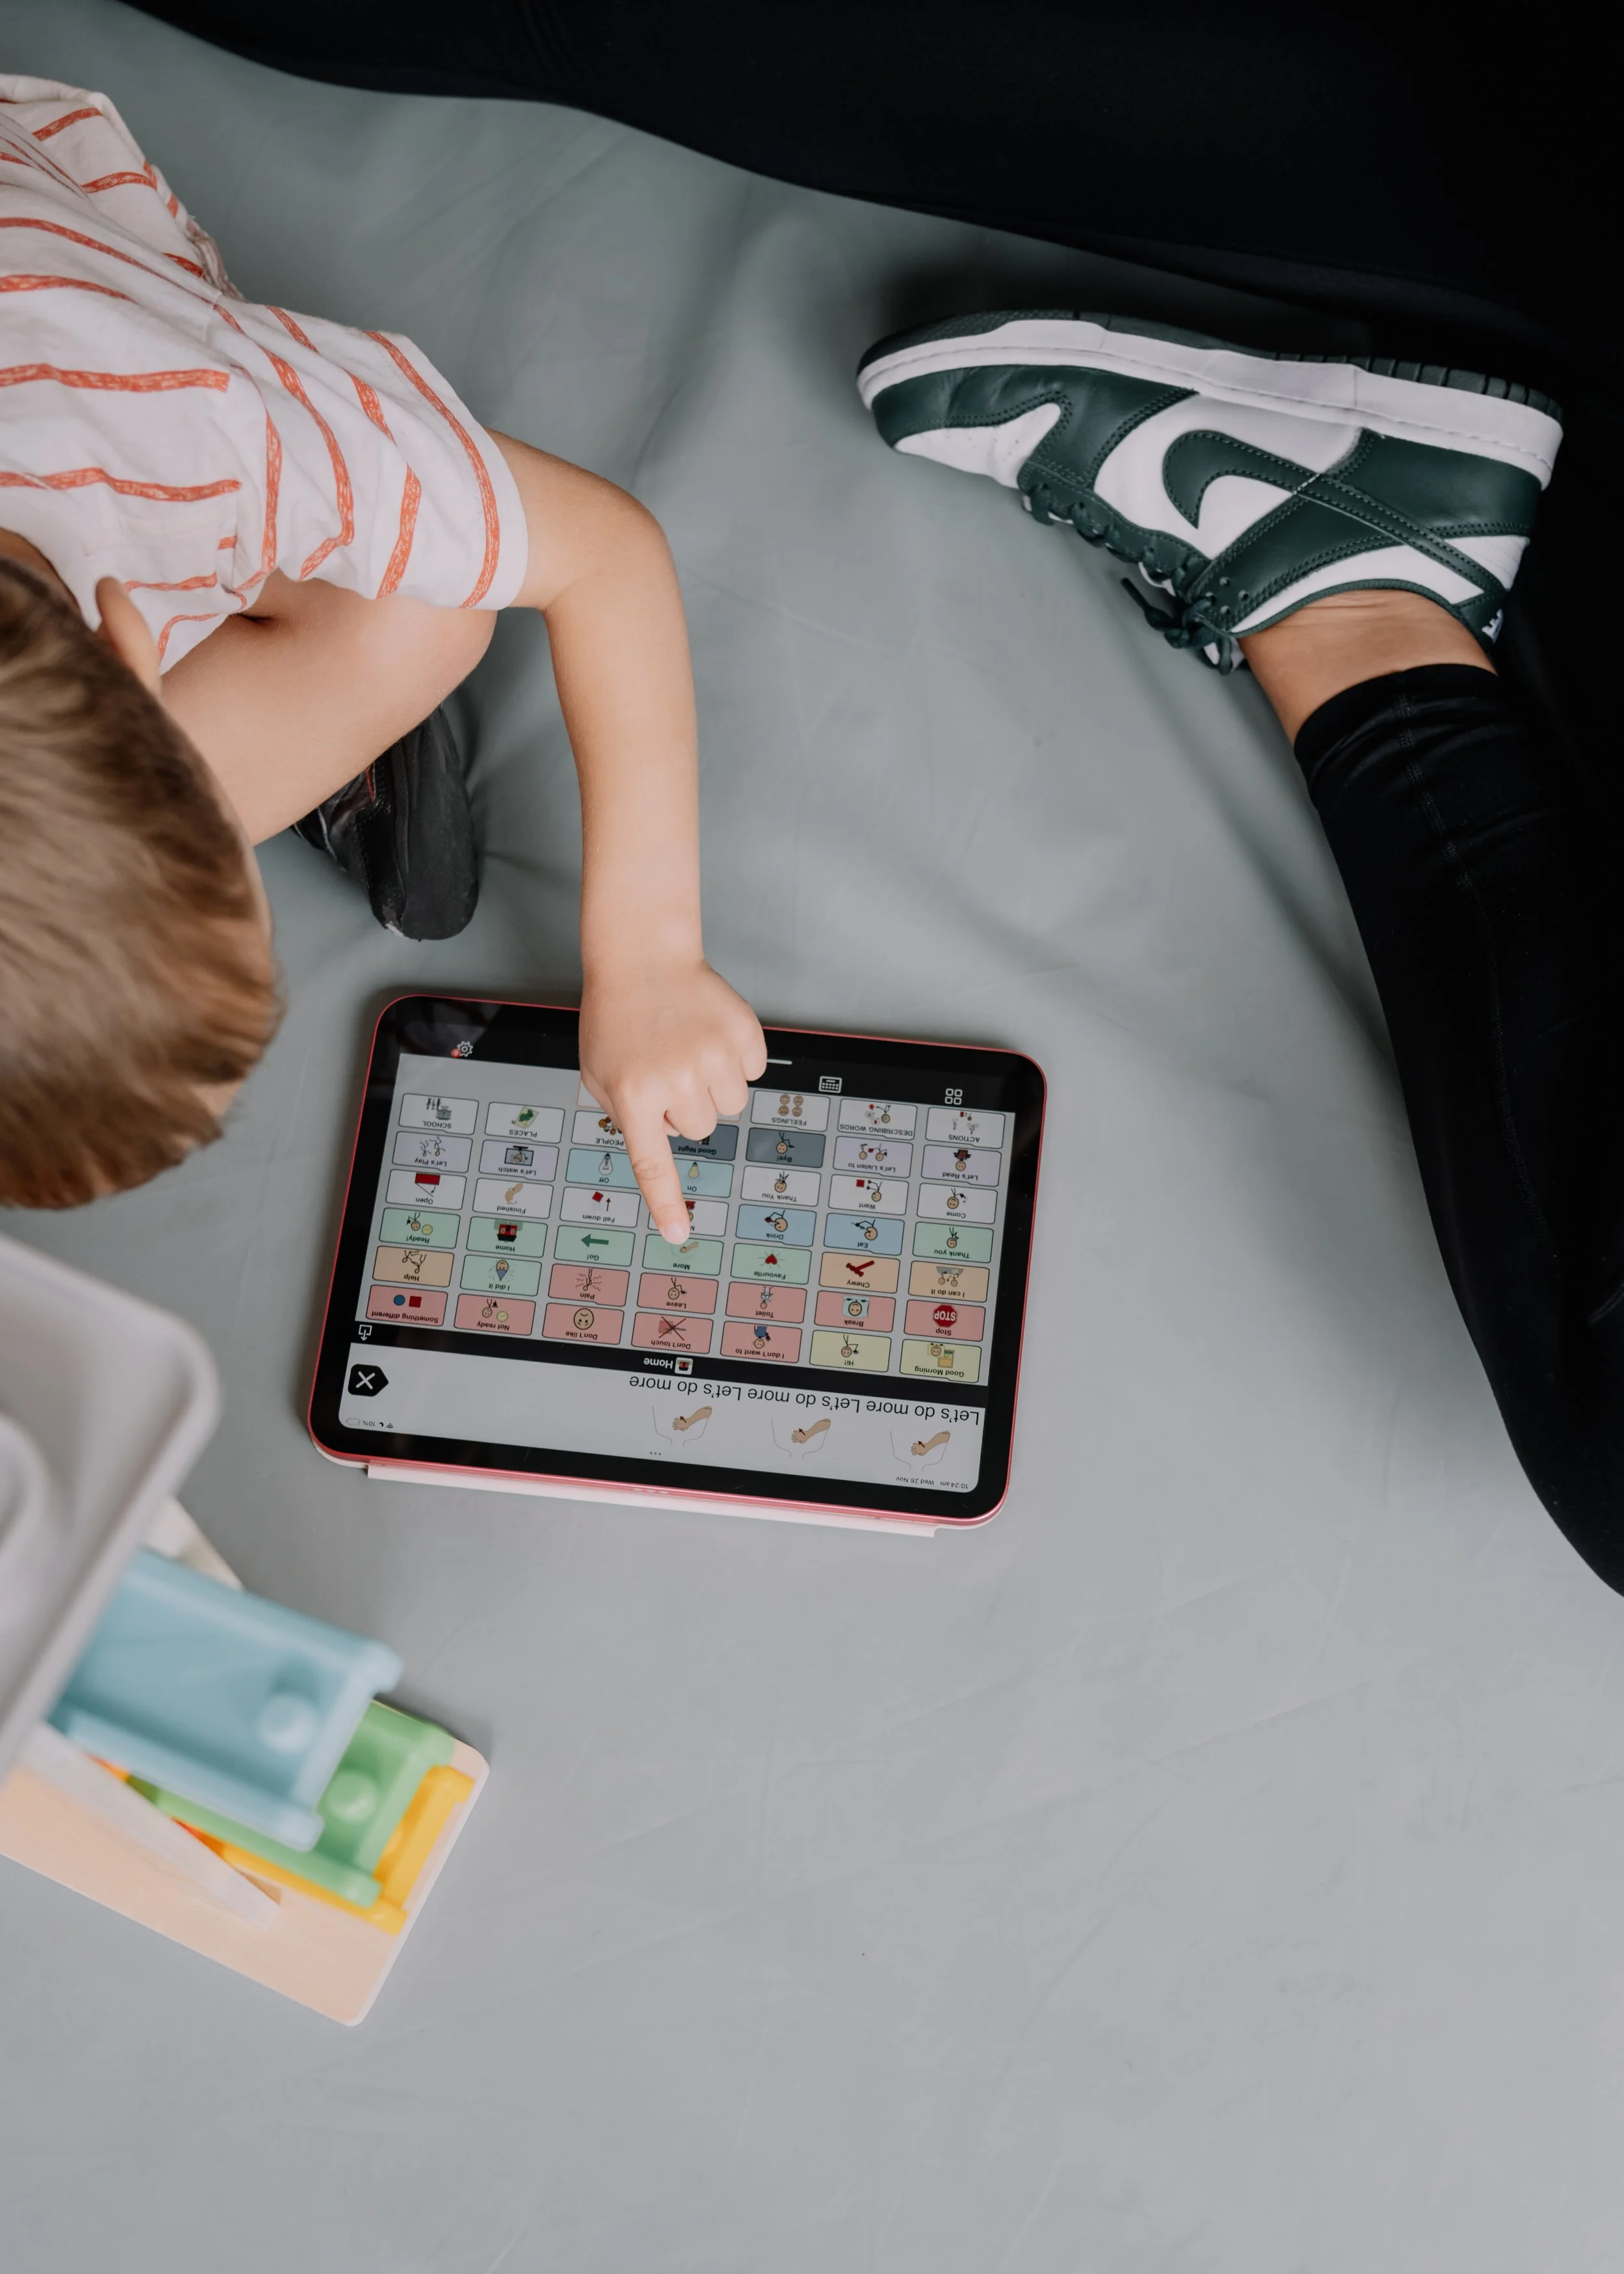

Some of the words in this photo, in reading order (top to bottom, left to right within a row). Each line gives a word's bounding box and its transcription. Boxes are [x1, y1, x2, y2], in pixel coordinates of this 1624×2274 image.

[422, 1120, 452, 1129] SCHOOL
[771, 1117, 807, 1127] FEELINGS
[509, 1129, 538, 1138] PLACES
[869, 1127, 913, 1137] DESCRIBING
[596, 1138, 624, 1147] PEOPLE
[948, 1134, 981, 1143] ACTIONS
[678, 1145, 697, 1154] Night
[414, 1157, 429, 1166] Play
[776, 1155, 793, 1164] Bye!
[496, 1206, 527, 1214] Finished
[946, 1211, 967, 1220] Come
[406, 1234, 430, 1244] Ready!
[948, 1251, 971, 1259] Thank
[672, 1262, 691, 1271] More
[403, 1273, 420, 1282] Help
[754, 1271, 787, 1281] Favourite
[846, 1279, 870, 1289] Chewy
[666, 1301, 687, 1310] Leave
[371, 1310, 401, 1320] different
[401, 1313, 439, 1323] Something
[755, 1310, 774, 1319] Toilet
[933, 1309, 957, 1321] STOP
[477, 1320, 496, 1329] ready
[935, 1327, 952, 1336] Stop
[672, 1342, 691, 1350] Don't
[762, 1351, 781, 1359] don't
[644, 1358, 673, 1369] Home
[915, 1366, 944, 1375] Morning
[945, 1370, 965, 1378] Good
[629, 1376, 672, 1390] more
[677, 1381, 698, 1396] do
[748, 1388, 790, 1403] more
[795, 1393, 817, 1409] do
[866, 1401, 909, 1415] more
[914, 1405, 935, 1421] do
